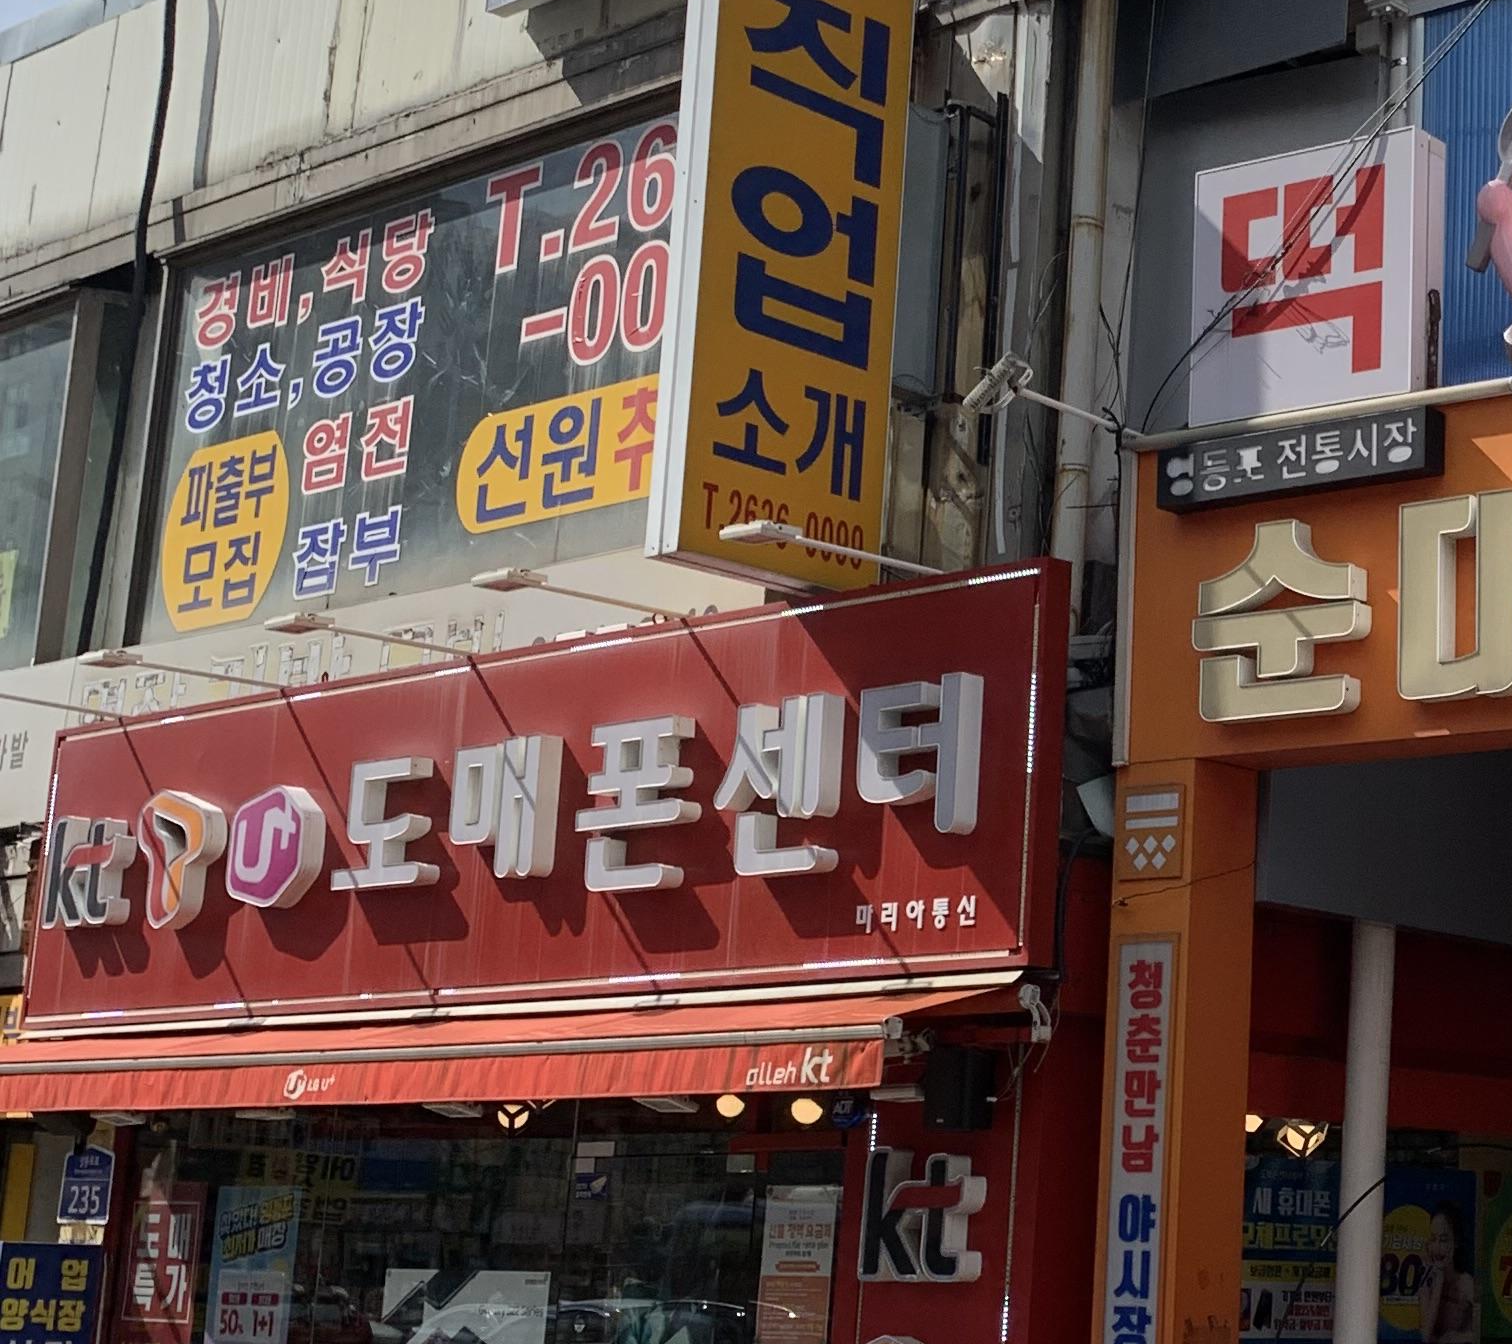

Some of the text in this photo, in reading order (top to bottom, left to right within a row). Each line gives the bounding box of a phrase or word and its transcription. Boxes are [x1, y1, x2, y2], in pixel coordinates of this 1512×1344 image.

[196, 209, 436, 349] 경비,식당
[1221, 164, 1386, 374] 떡
[186, 297, 424, 433] 청소,공장
[303, 396, 413, 494] 염전
[712, 369, 868, 502] 소개
[1276, 418, 1418, 478] 전통시장
[181, 444, 277, 532] 파출부
[177, 536, 259, 613] 모집
[293, 506, 403, 599] 잡부
[330, 672, 984, 892] 도매폰센터
[42, 817, 137, 929] kt
[856, 895, 977, 933] 마리아통신
[746, 1048, 834, 1086] olleh kt
[1121, 960, 1164, 1173] 청춘만남
[67, 1185, 102, 1214] 235
[858, 1146, 972, 1281] kt
[1278, 1187, 1332, 1219] 휴대폰
[132, 1264, 187, 1313] 특가
